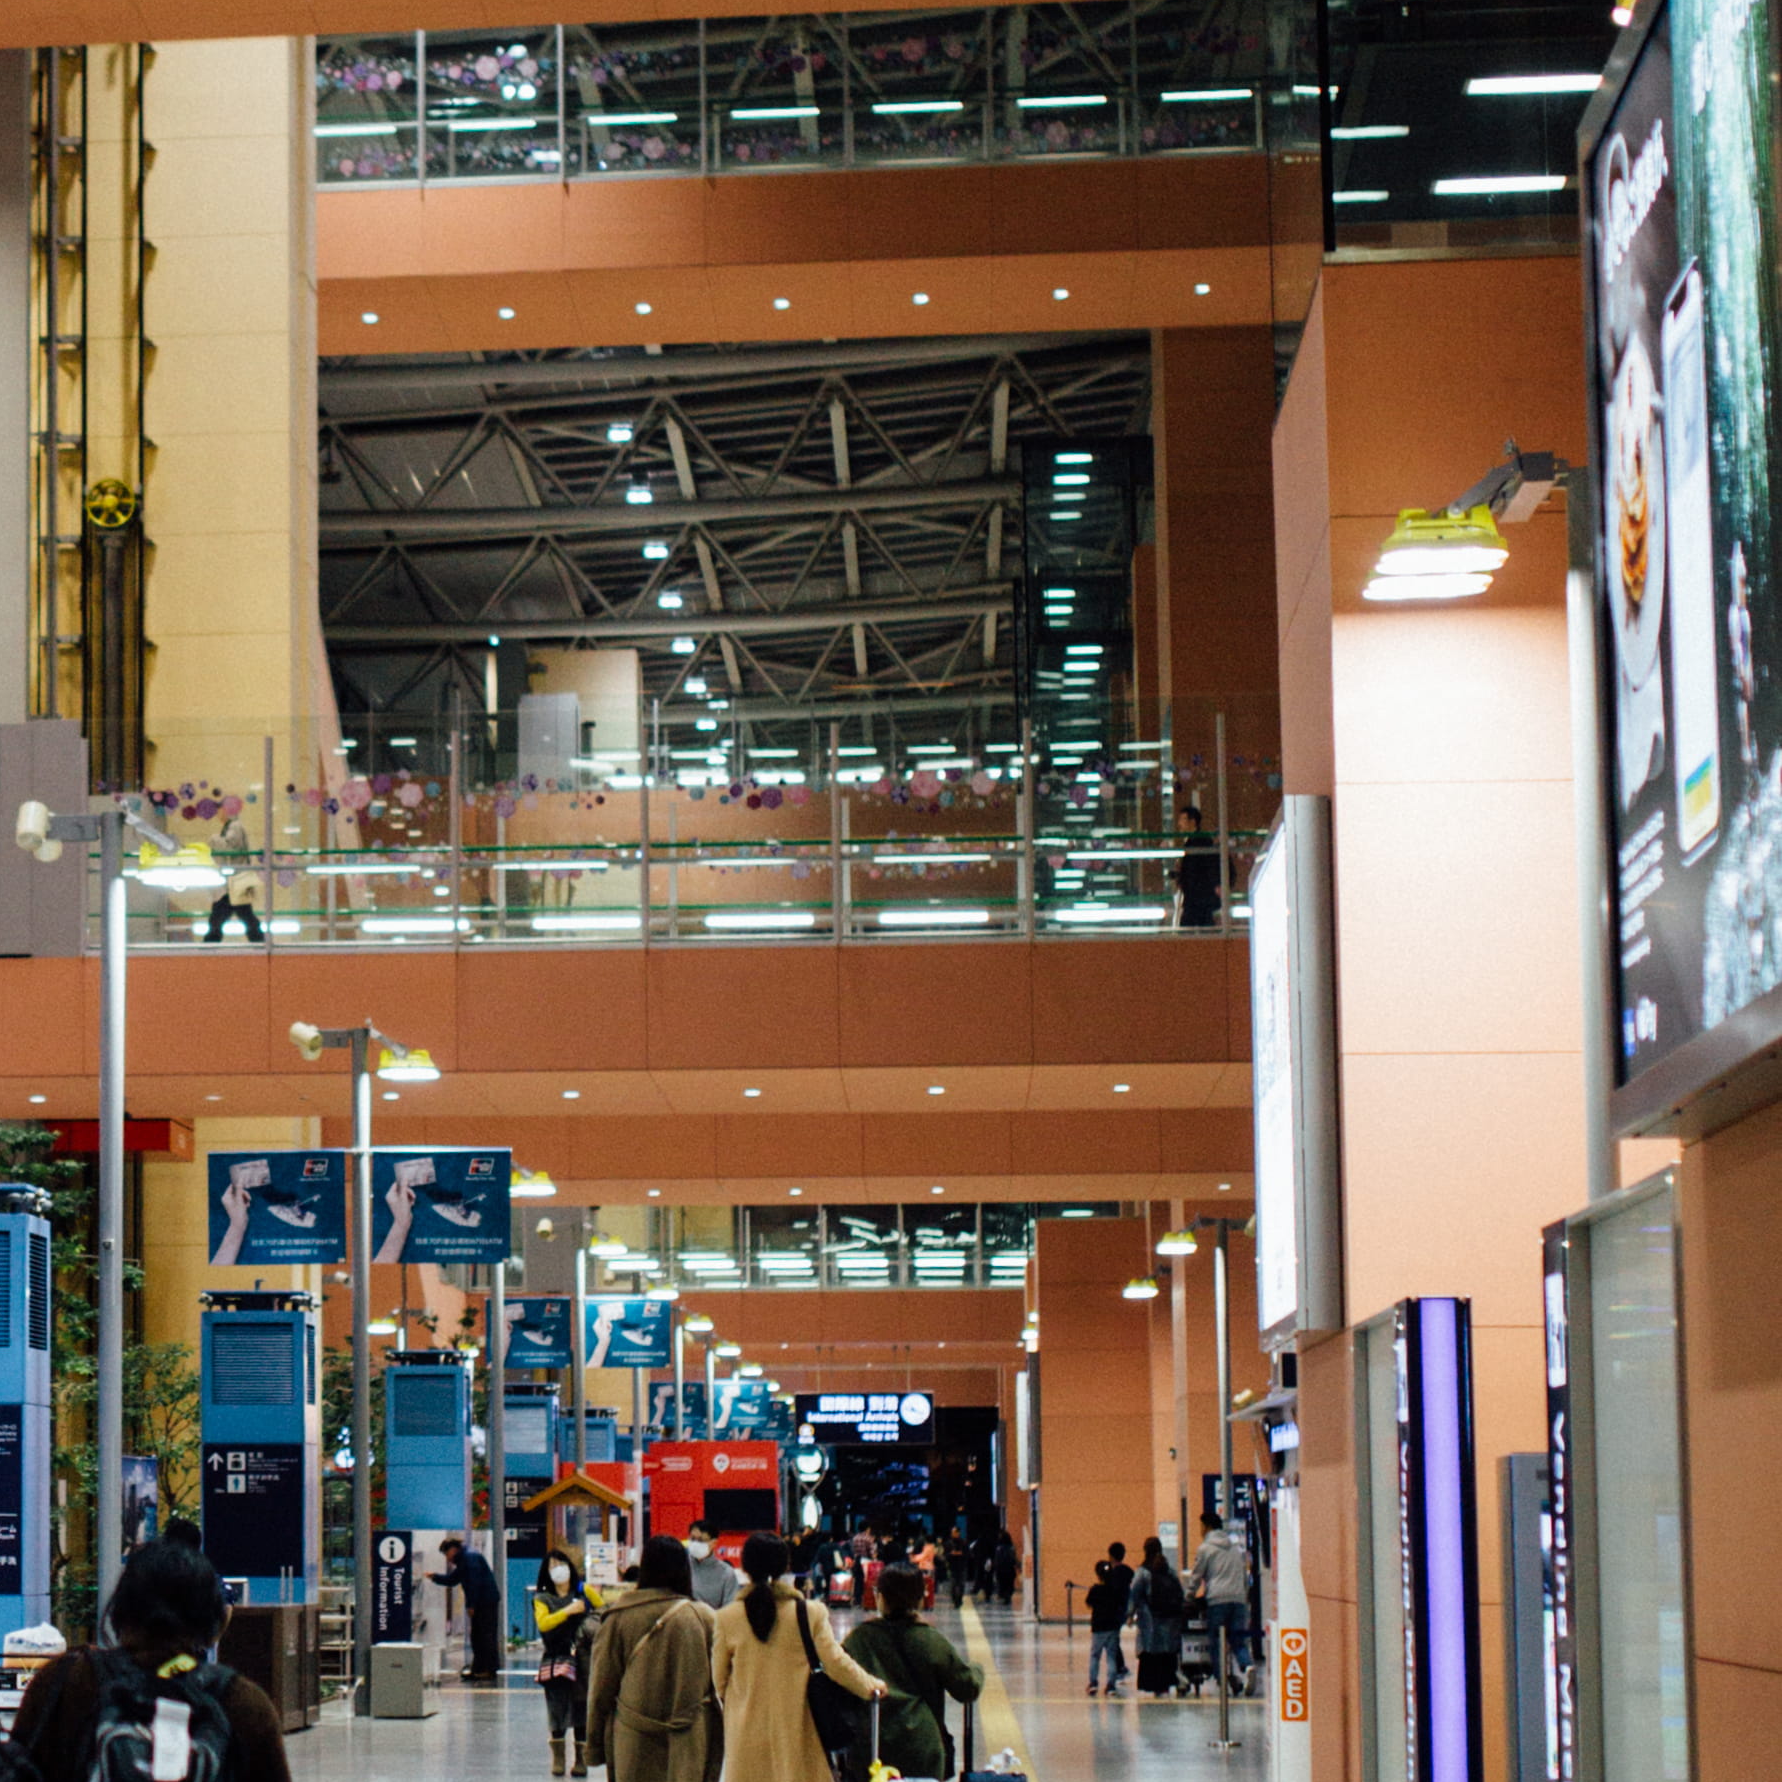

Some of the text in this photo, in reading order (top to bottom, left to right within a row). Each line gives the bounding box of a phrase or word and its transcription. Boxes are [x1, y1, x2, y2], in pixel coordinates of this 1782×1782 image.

[379, 1566, 390, 1631] Information
[393, 1567, 406, 1605] Tourist
[1284, 1657, 1304, 1719] AED
